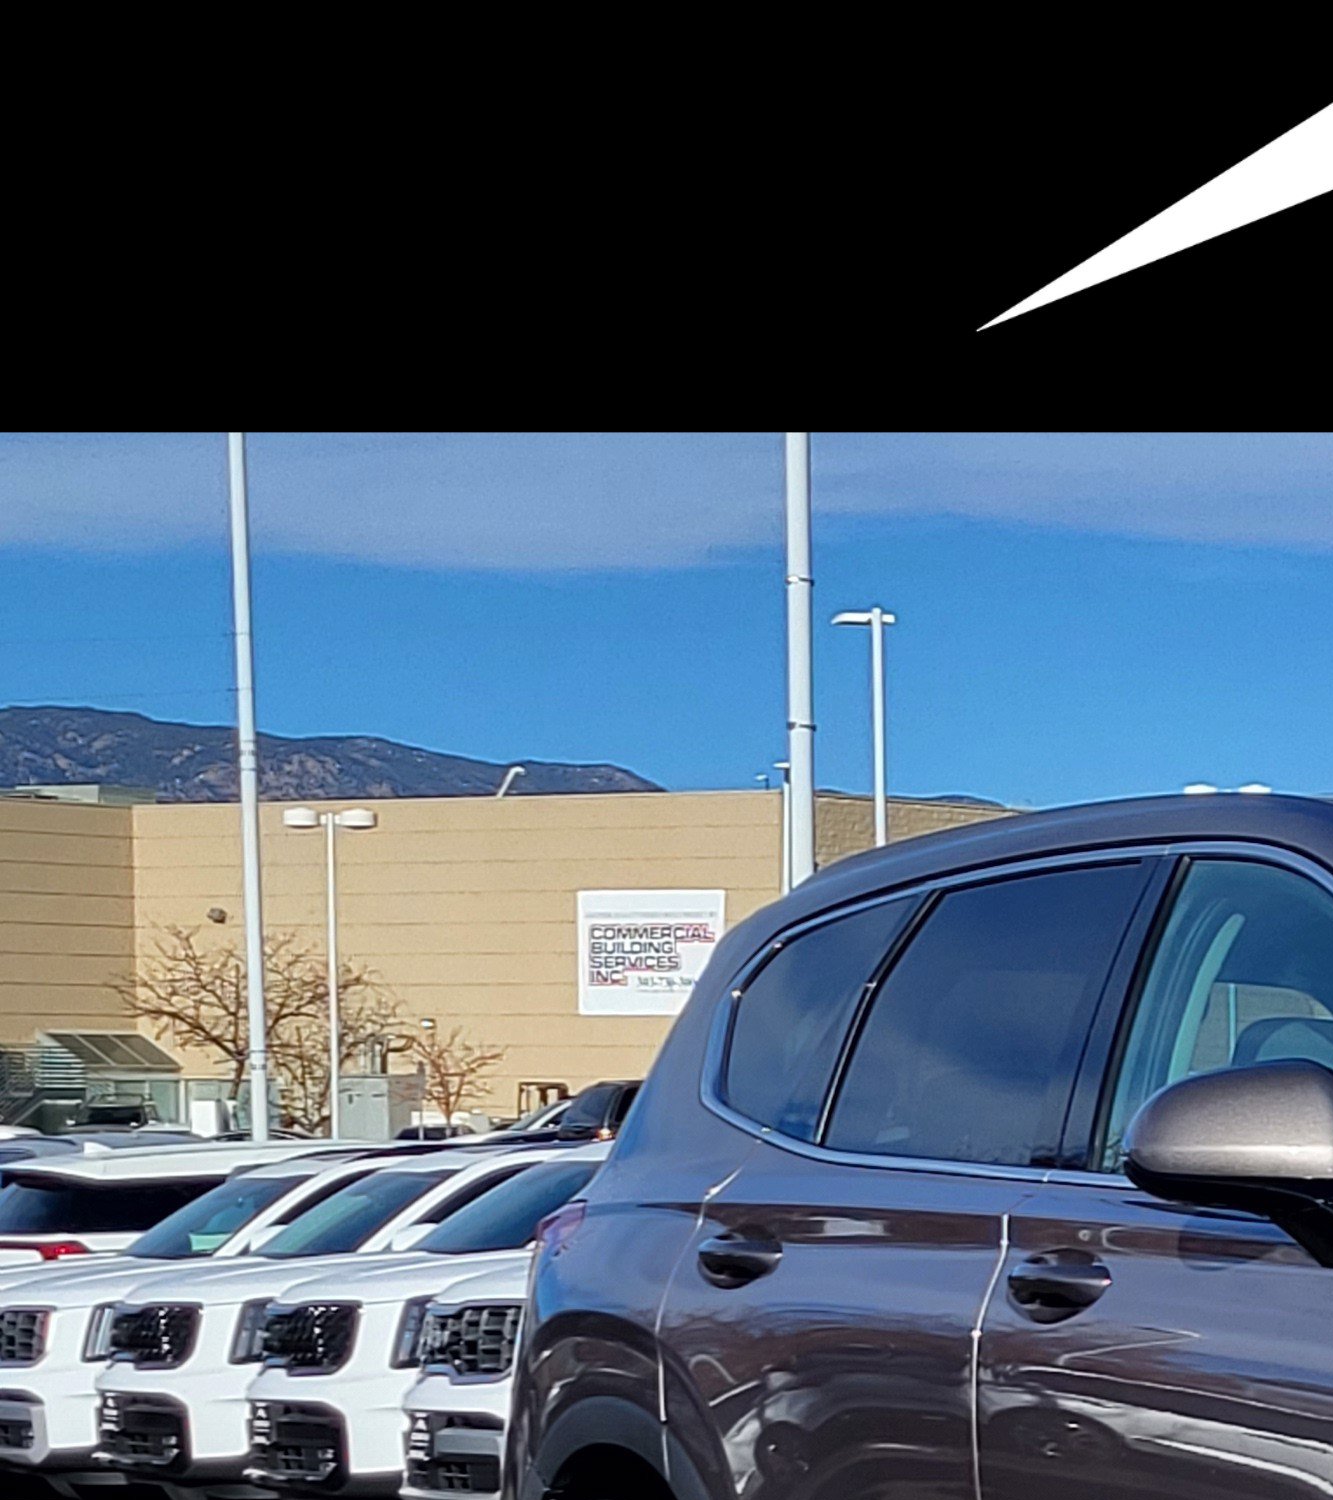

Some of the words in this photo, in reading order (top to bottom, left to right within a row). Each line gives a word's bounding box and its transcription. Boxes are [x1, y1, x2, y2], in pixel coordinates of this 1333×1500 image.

[590, 925, 713, 941] COMMERCIAL
[591, 941, 674, 955] BUILDING
[590, 955, 680, 970] SERVICES
